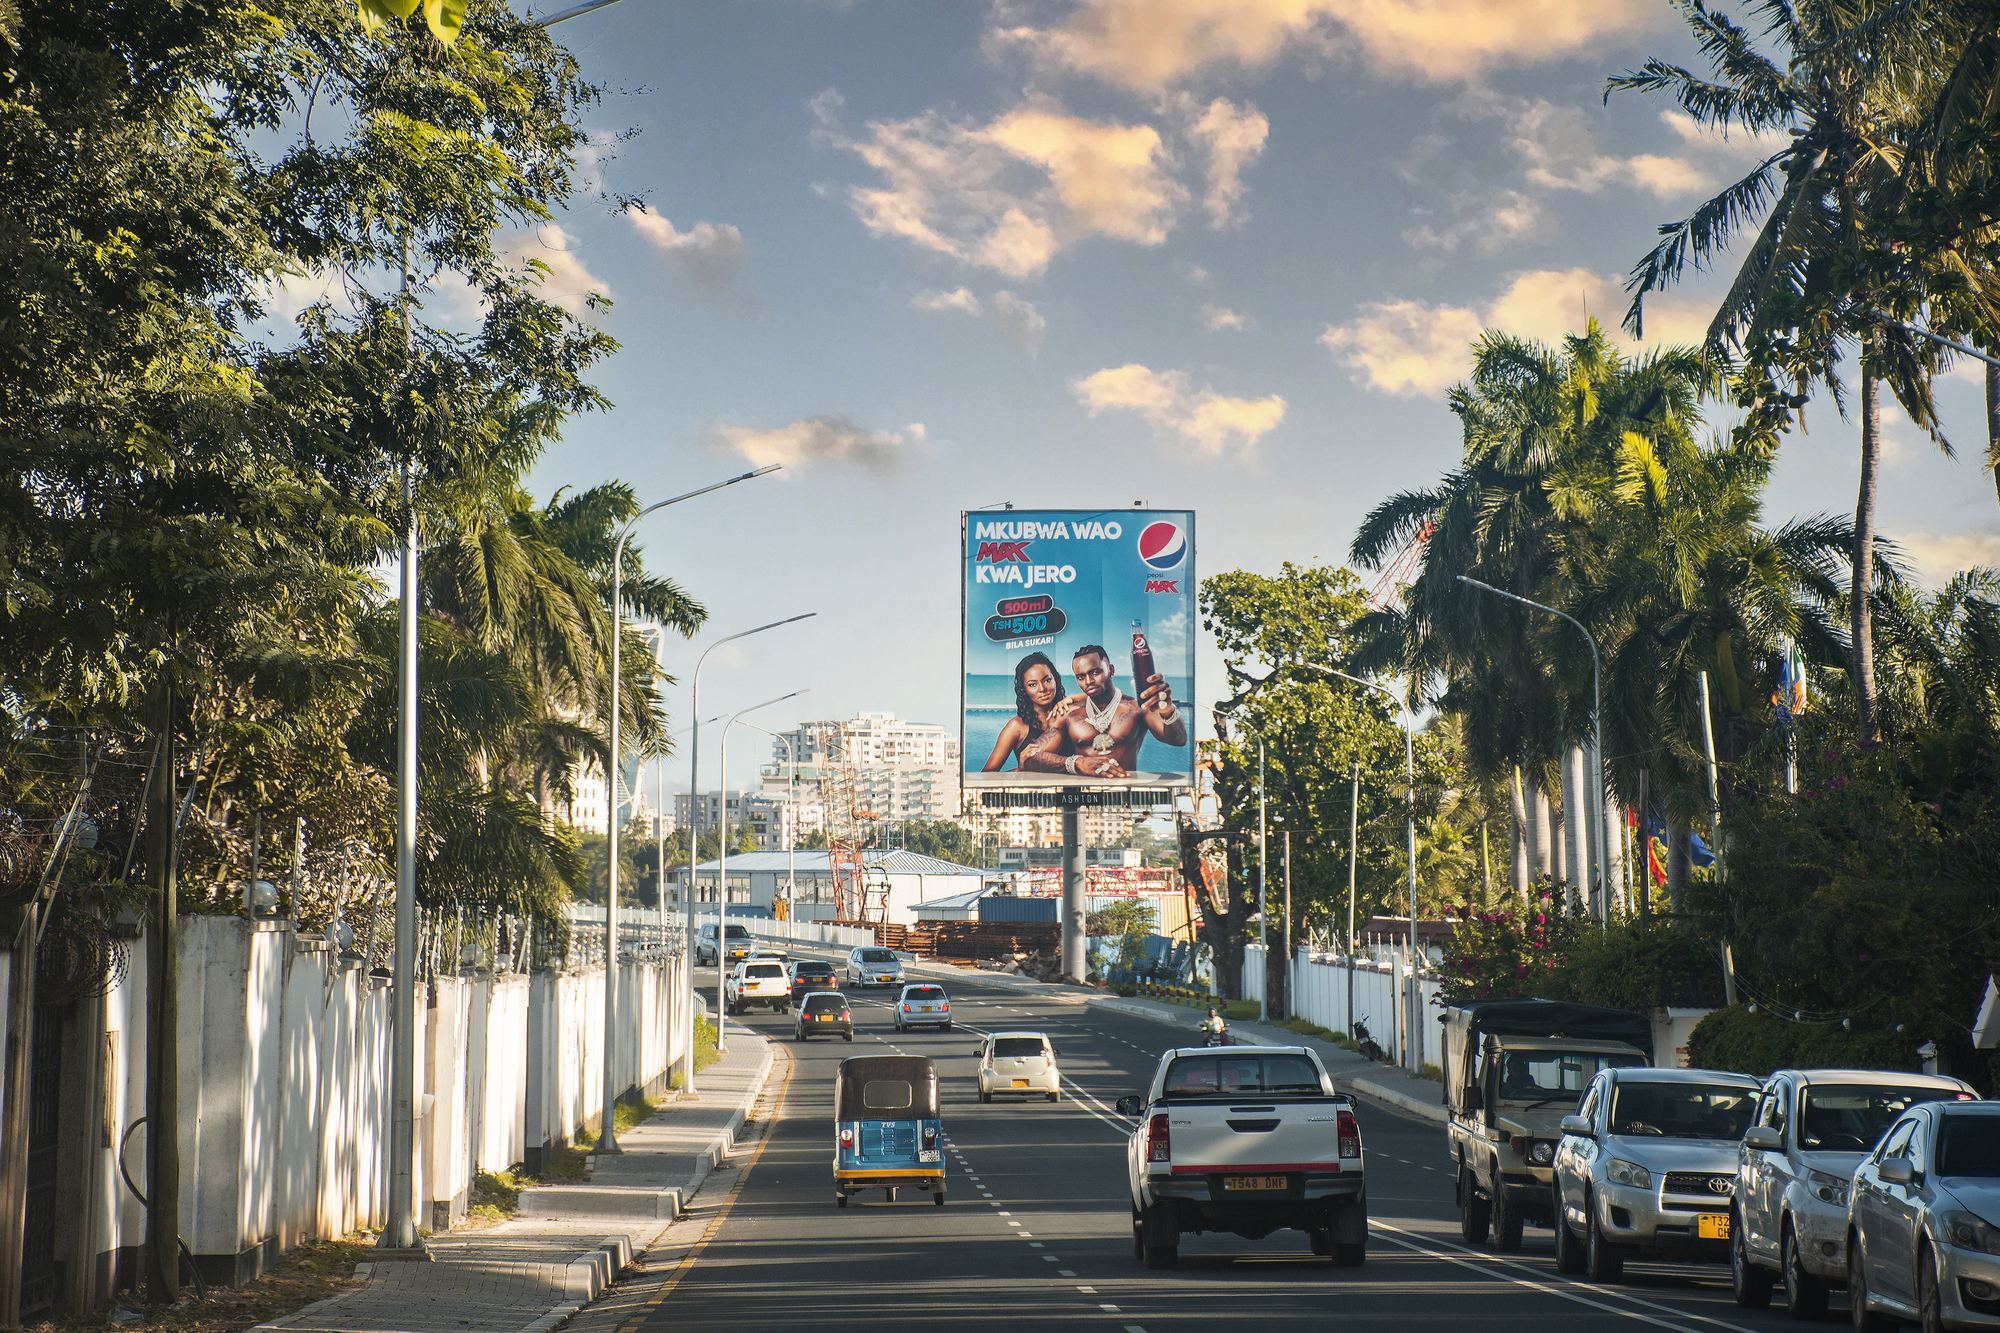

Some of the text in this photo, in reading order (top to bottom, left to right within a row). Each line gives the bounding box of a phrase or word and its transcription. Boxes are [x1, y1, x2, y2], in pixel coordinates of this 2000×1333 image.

[975, 521, 1122, 540] MKUBWA WAO
[976, 540, 1034, 564] MAX
[976, 565, 1077, 589] KWA JERO
[1144, 579, 1180, 594] MAX
[1004, 597, 1046, 614] 500ml
[992, 614, 1047, 634] TSH 500
[1005, 636, 1054, 650] BILA SUKARI
[1231, 1177, 1285, 1189] T548 DNF
[1711, 1216, 1729, 1226] T32
[1717, 1228, 1729, 1237] CH
